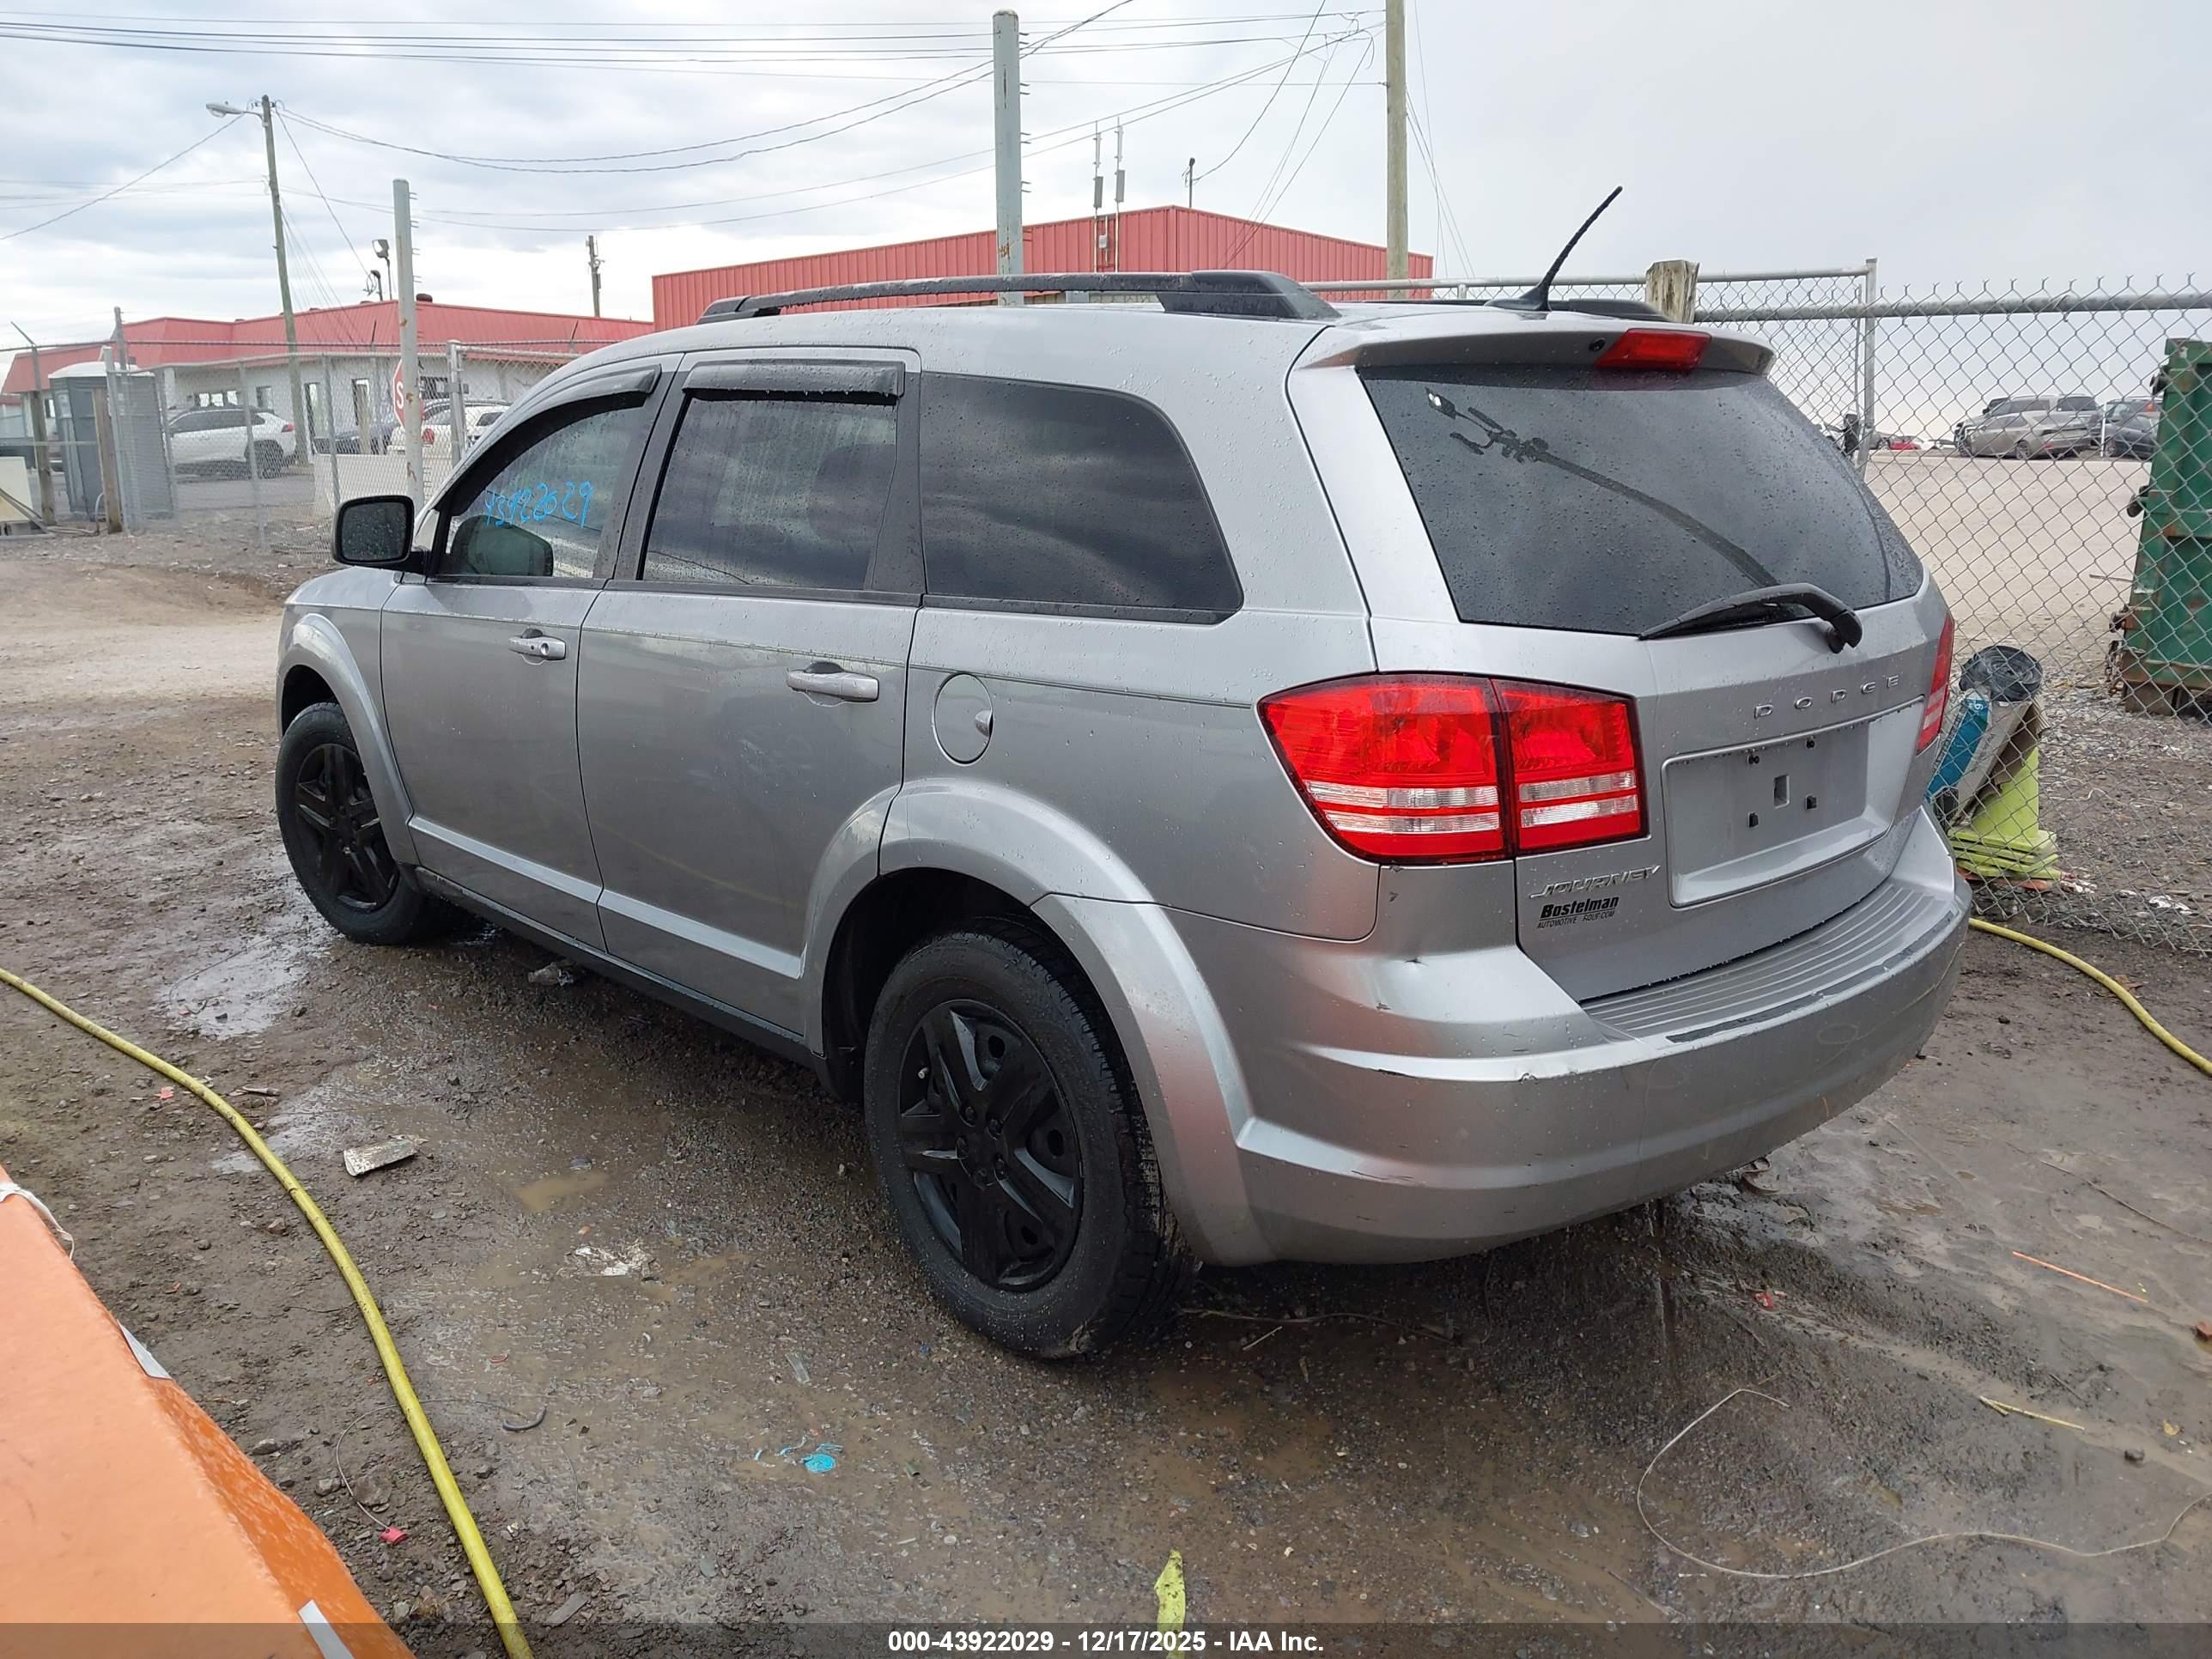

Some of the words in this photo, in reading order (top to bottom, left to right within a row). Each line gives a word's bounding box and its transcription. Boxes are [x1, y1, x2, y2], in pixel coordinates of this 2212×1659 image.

[1753, 675, 1899, 719] DODGE
[1529, 865, 1661, 898] JOURNEY
[1540, 896, 1620, 919] Bostelman
[1536, 916, 1577, 929] AUTOMOTIVE
